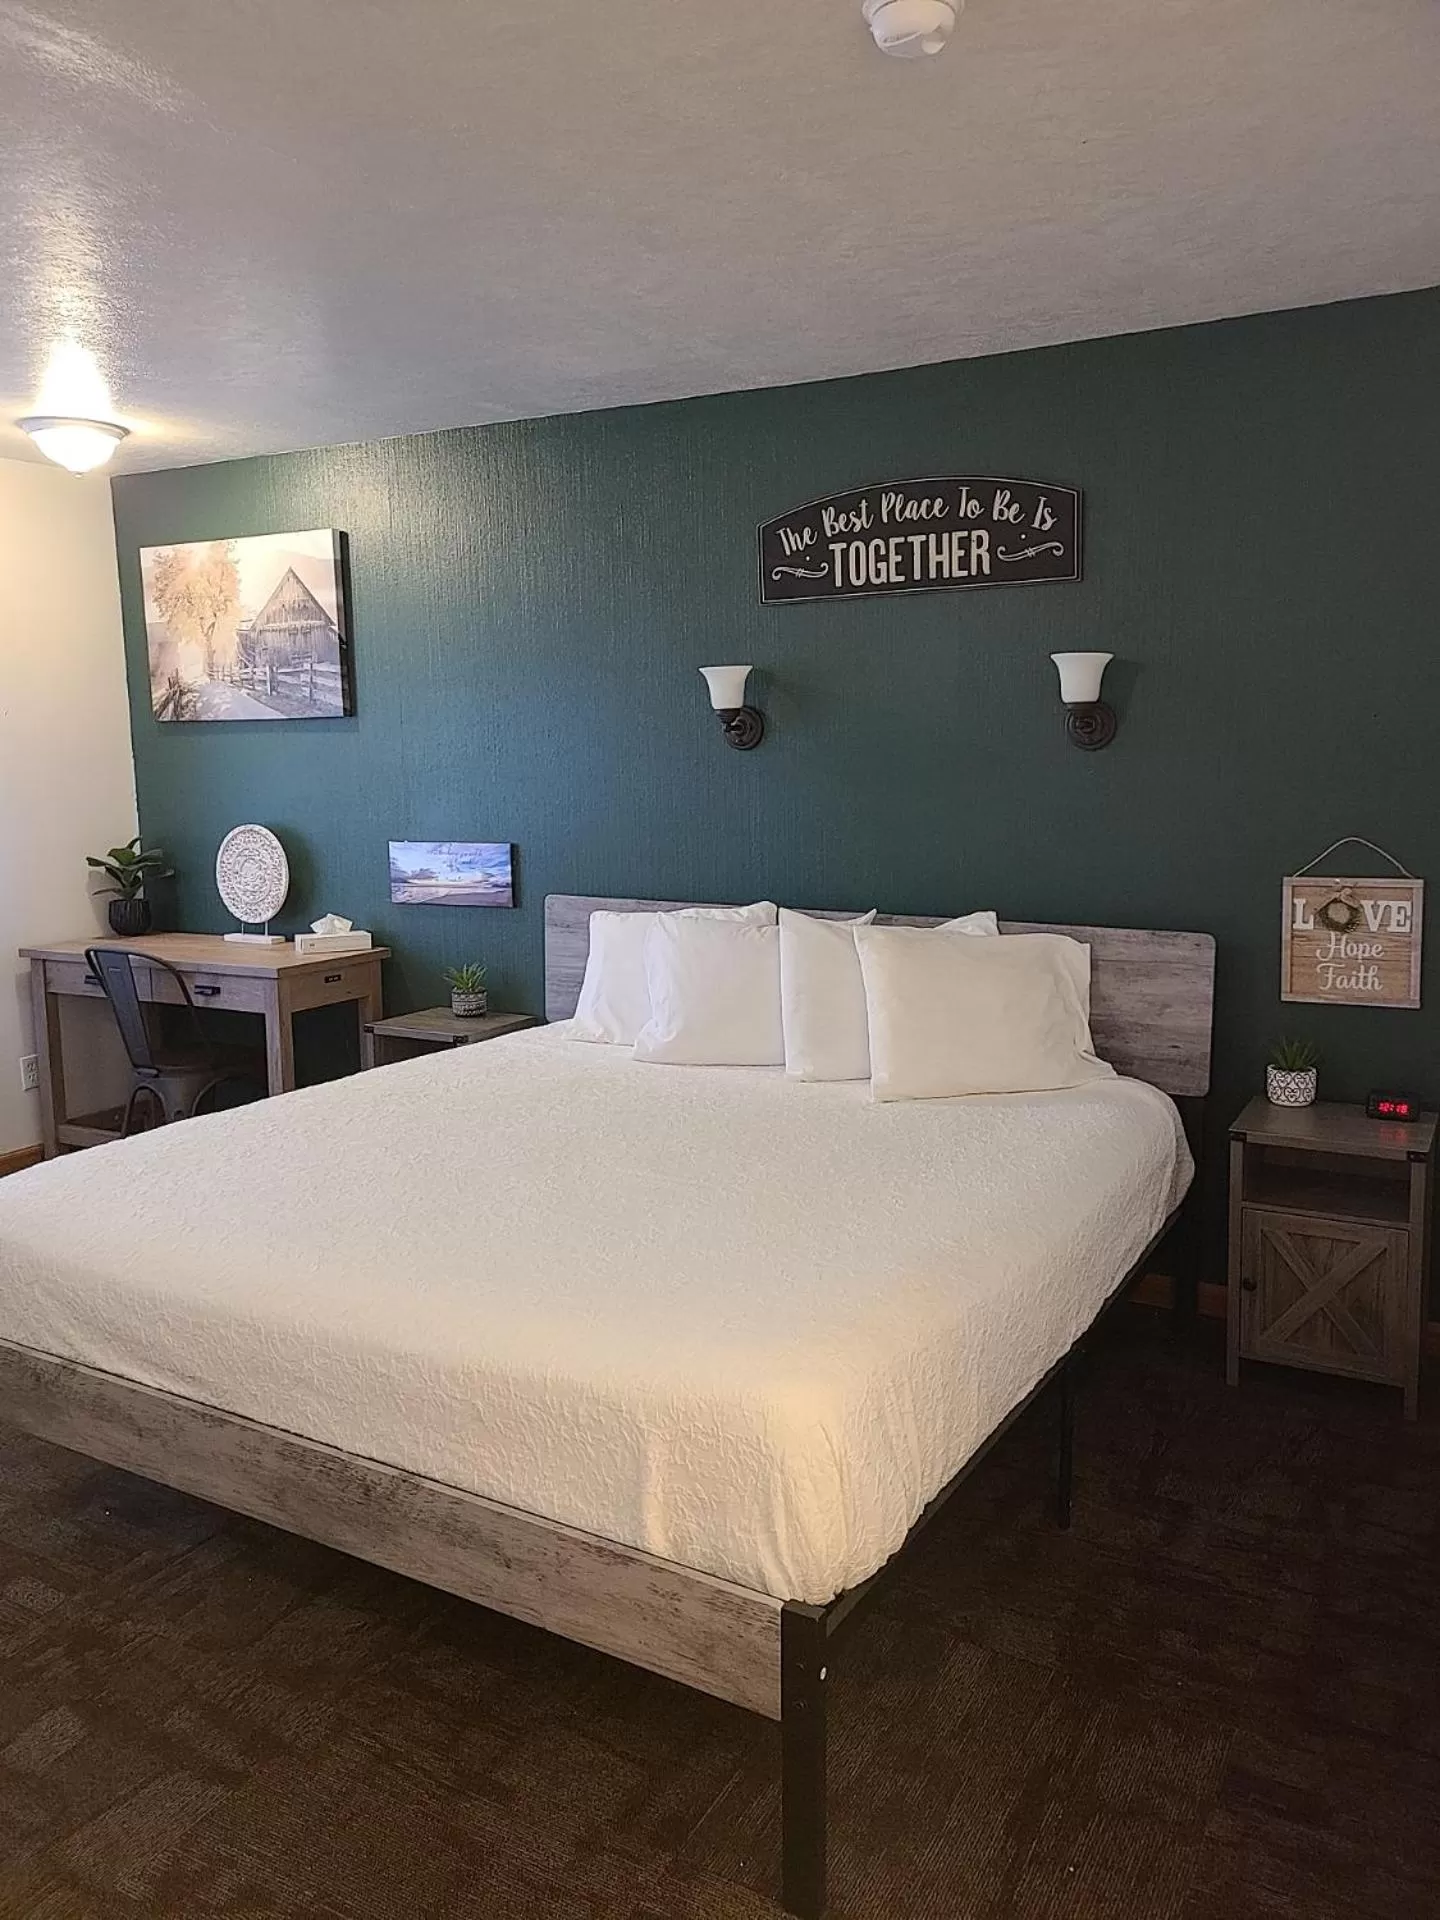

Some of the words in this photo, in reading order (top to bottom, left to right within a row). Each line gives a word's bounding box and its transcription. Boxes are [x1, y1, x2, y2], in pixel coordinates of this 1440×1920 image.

[776, 525, 818, 556] The
[821, 499, 874, 538] Best
[880, 491, 949, 523] Place
[958, 486, 984, 518] To
[992, 489, 1026, 524] Be
[1031, 496, 1057, 531] Is
[829, 529, 991, 588] TOGETHER
[1315, 931, 1384, 962] Hope
[1316, 962, 1384, 991] Faith
